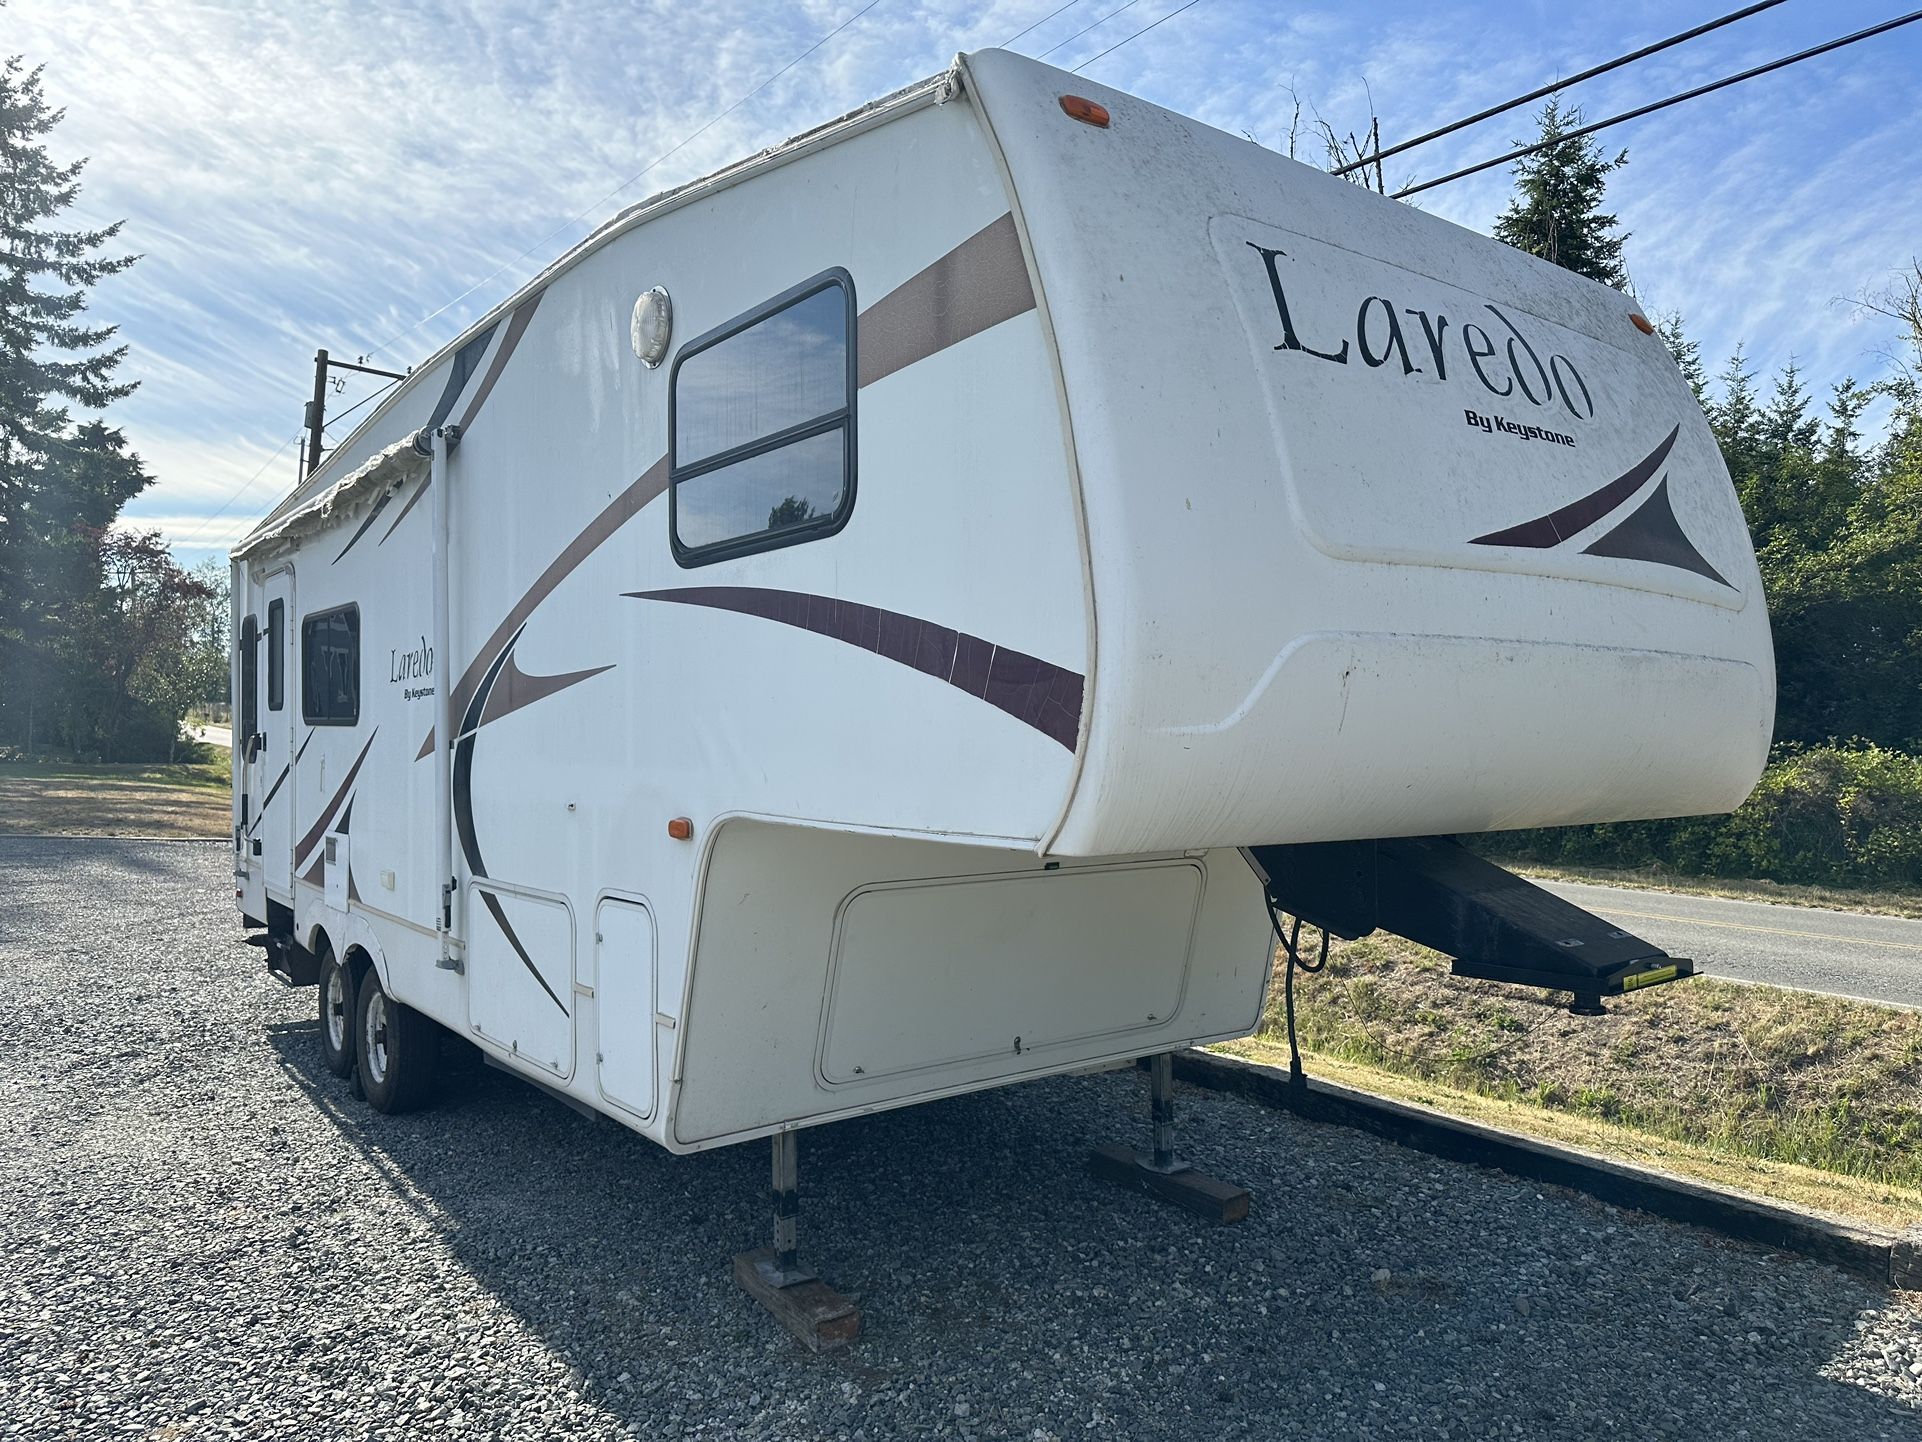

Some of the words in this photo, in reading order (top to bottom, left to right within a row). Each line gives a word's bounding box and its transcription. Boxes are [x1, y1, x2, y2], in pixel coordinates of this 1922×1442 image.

[1246, 241, 1593, 420] Laredo
[1464, 409, 1493, 433] By
[1494, 415, 1576, 448] Keystone
[390, 635, 434, 683] Laredo
[404, 689, 411, 701] By
[412, 687, 435, 700] Keystone
